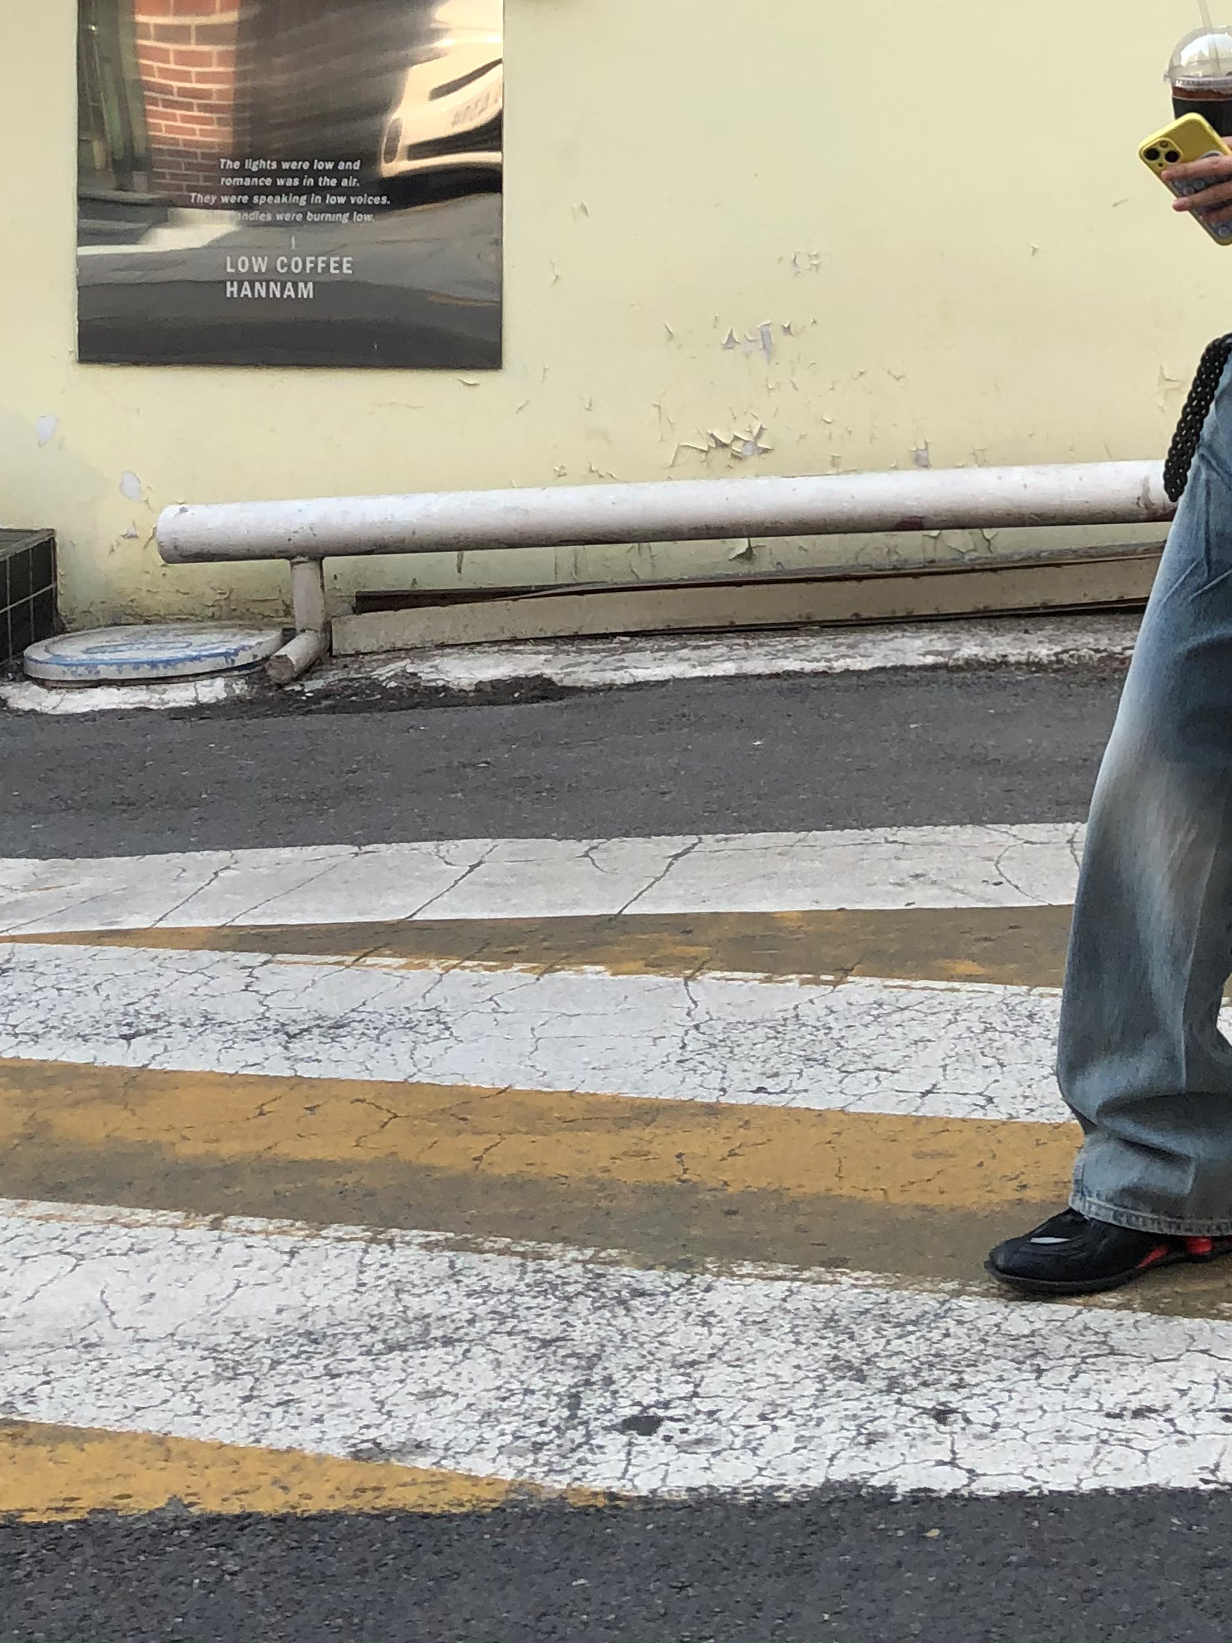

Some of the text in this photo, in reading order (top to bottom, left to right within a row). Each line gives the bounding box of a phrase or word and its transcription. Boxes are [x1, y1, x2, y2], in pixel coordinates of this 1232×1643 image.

[219, 158, 361, 172] The lights were low and
[220, 175, 361, 187] romance was in the air.
[189, 192, 391, 206] They were speaking in low voices.
[275, 212, 303, 222] were
[306, 210, 350, 224] burning
[226, 256, 353, 274] LOW COFFEE
[226, 280, 314, 298] HANNAM
